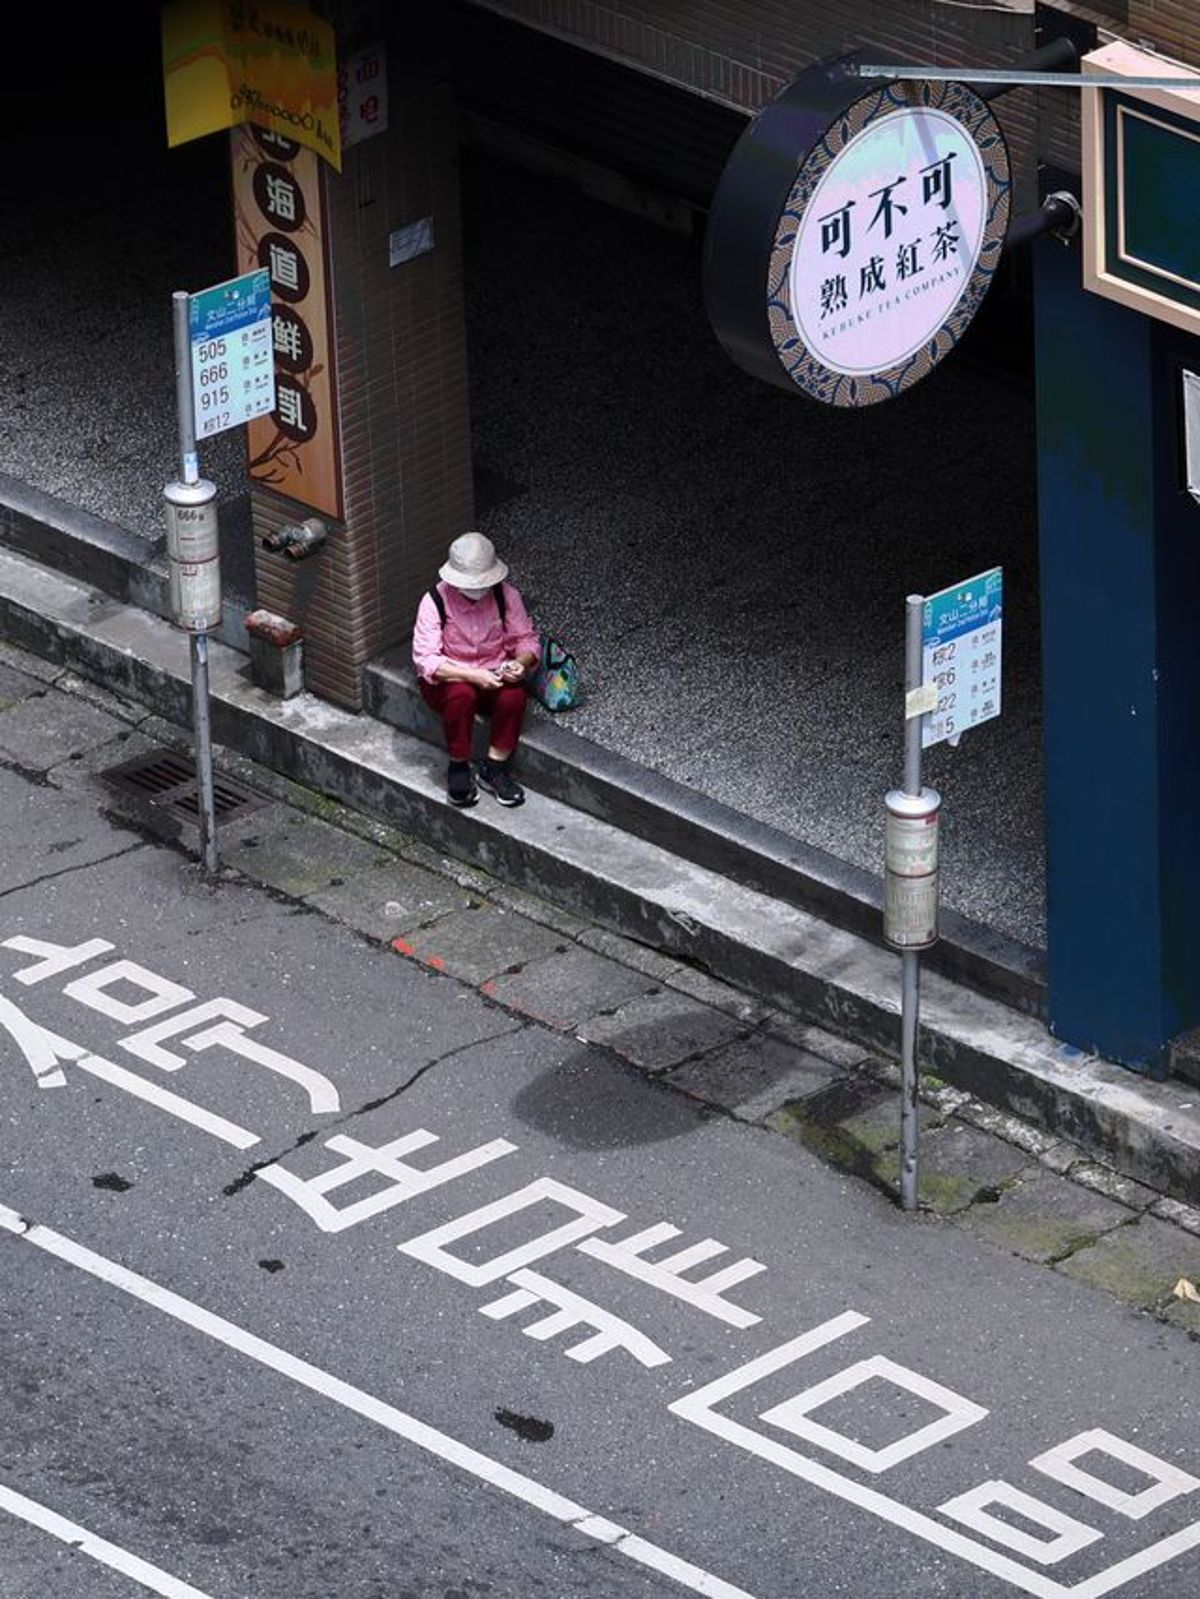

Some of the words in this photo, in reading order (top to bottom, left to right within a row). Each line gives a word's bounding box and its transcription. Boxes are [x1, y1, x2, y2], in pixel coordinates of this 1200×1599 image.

[817, 152, 958, 260] 可不可
[819, 219, 961, 321] 熟成紅茶
[199, 338, 228, 364] 505
[200, 362, 228, 387] 666
[201, 386, 230, 411] 915
